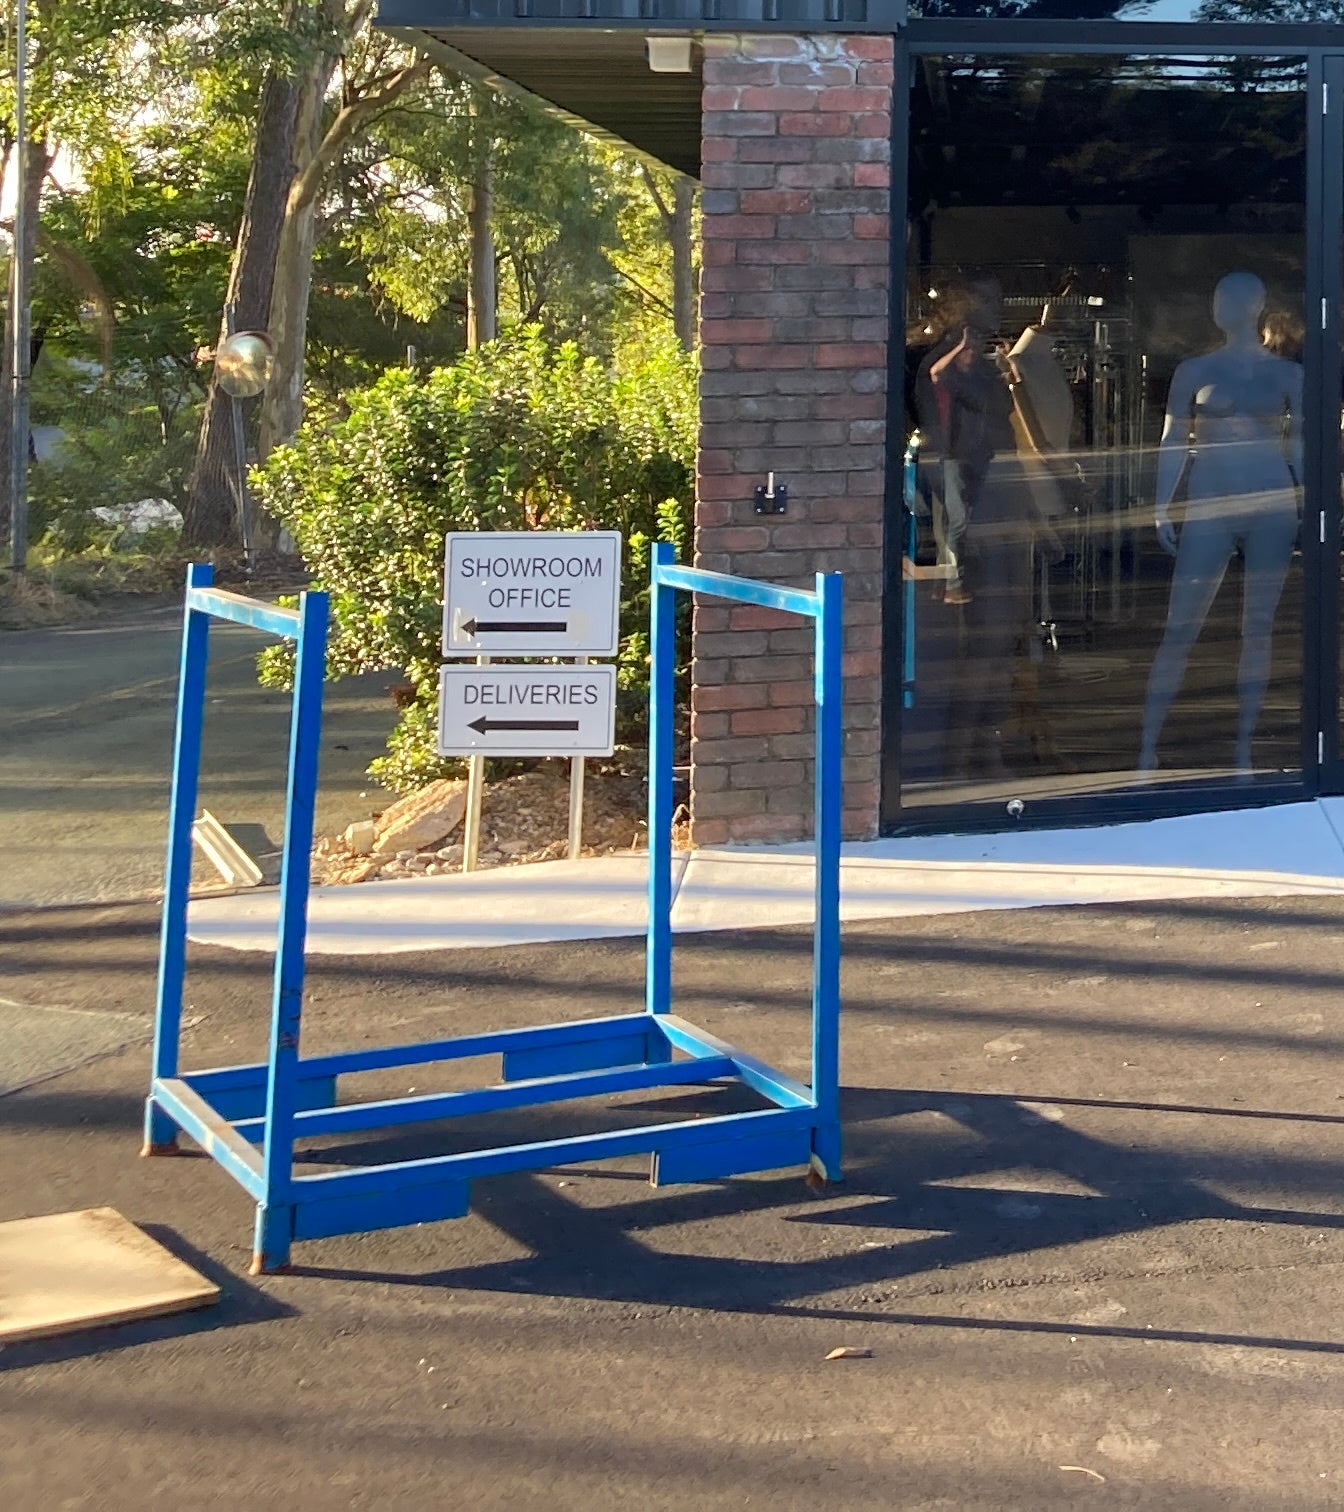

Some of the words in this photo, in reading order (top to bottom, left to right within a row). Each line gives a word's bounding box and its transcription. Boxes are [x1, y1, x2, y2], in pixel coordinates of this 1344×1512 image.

[460, 557, 603, 578] SHOWROOM
[488, 588, 572, 608] OFFICE
[464, 684, 599, 705] DELIVERIES
